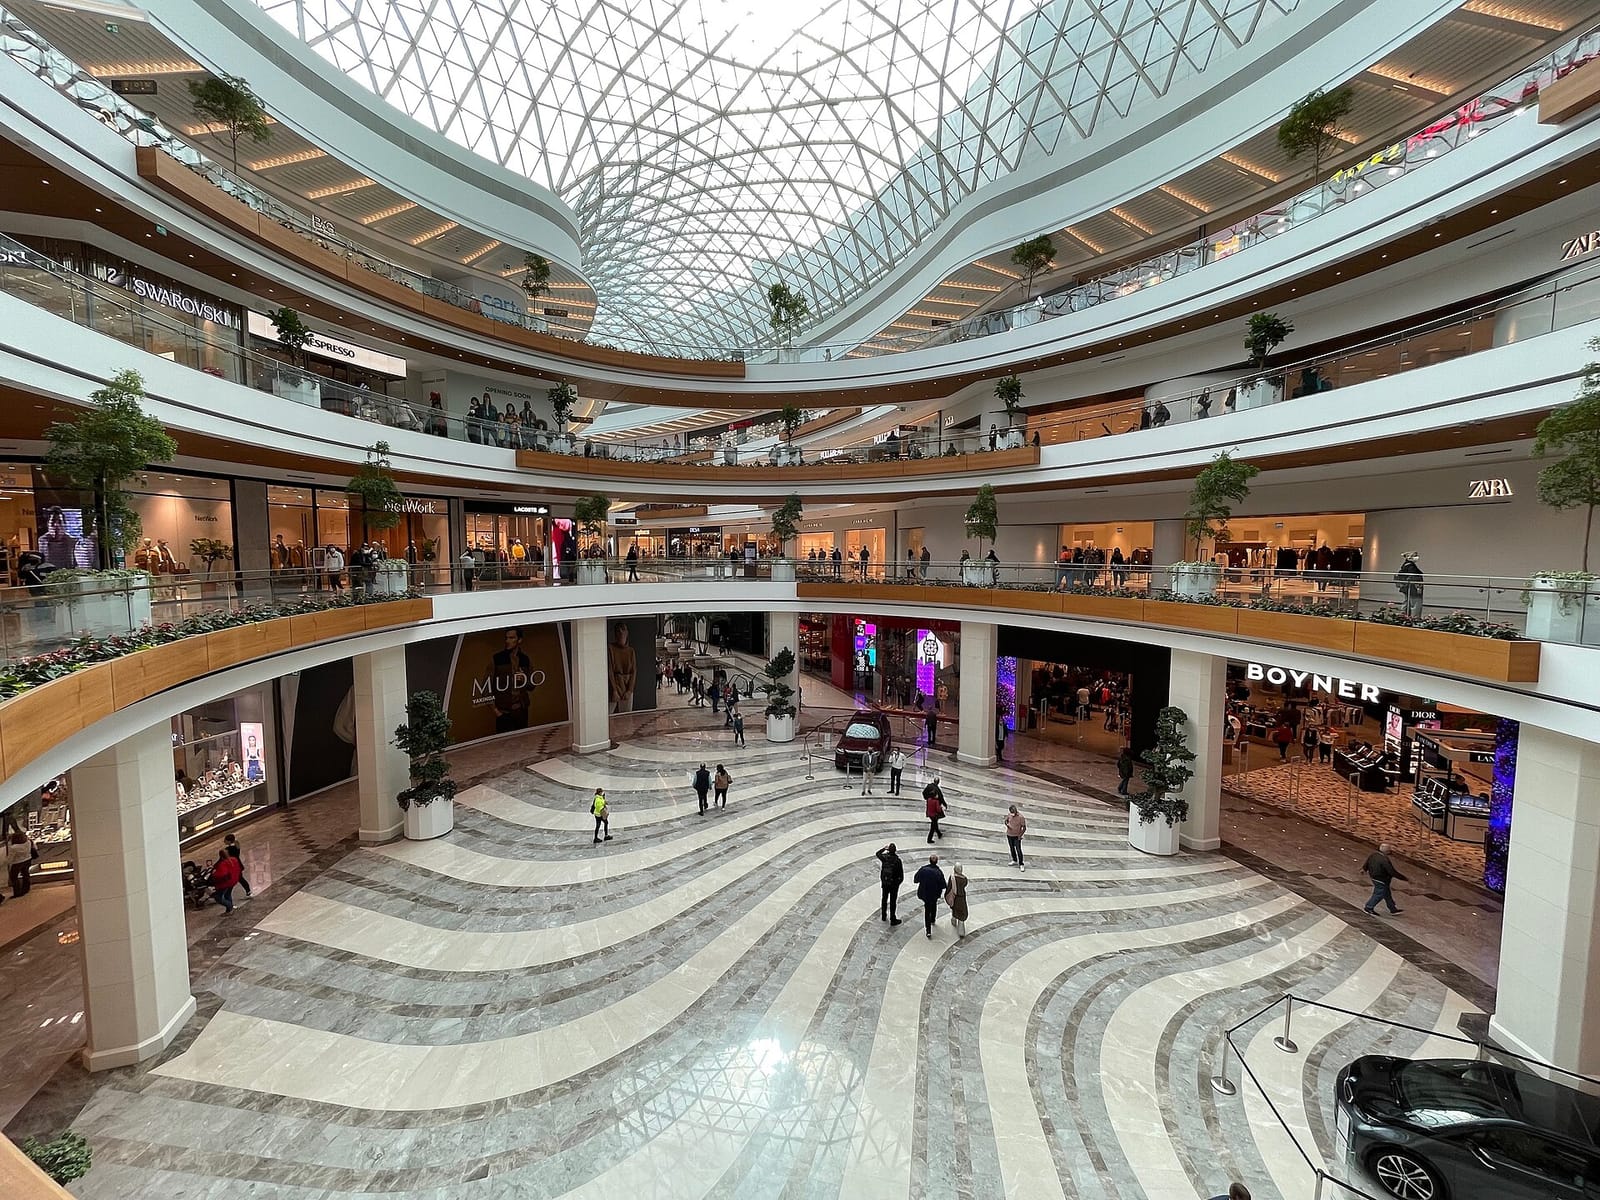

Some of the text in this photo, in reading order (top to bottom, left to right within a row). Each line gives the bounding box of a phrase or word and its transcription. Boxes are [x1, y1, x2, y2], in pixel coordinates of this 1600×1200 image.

[134, 279, 229, 326] SWAROVSKI
[1468, 479, 1513, 498] ZARA
[472, 670, 546, 698] MUDO
[1246, 662, 1380, 704] BOYNER
[1411, 711, 1437, 720] DIOR
